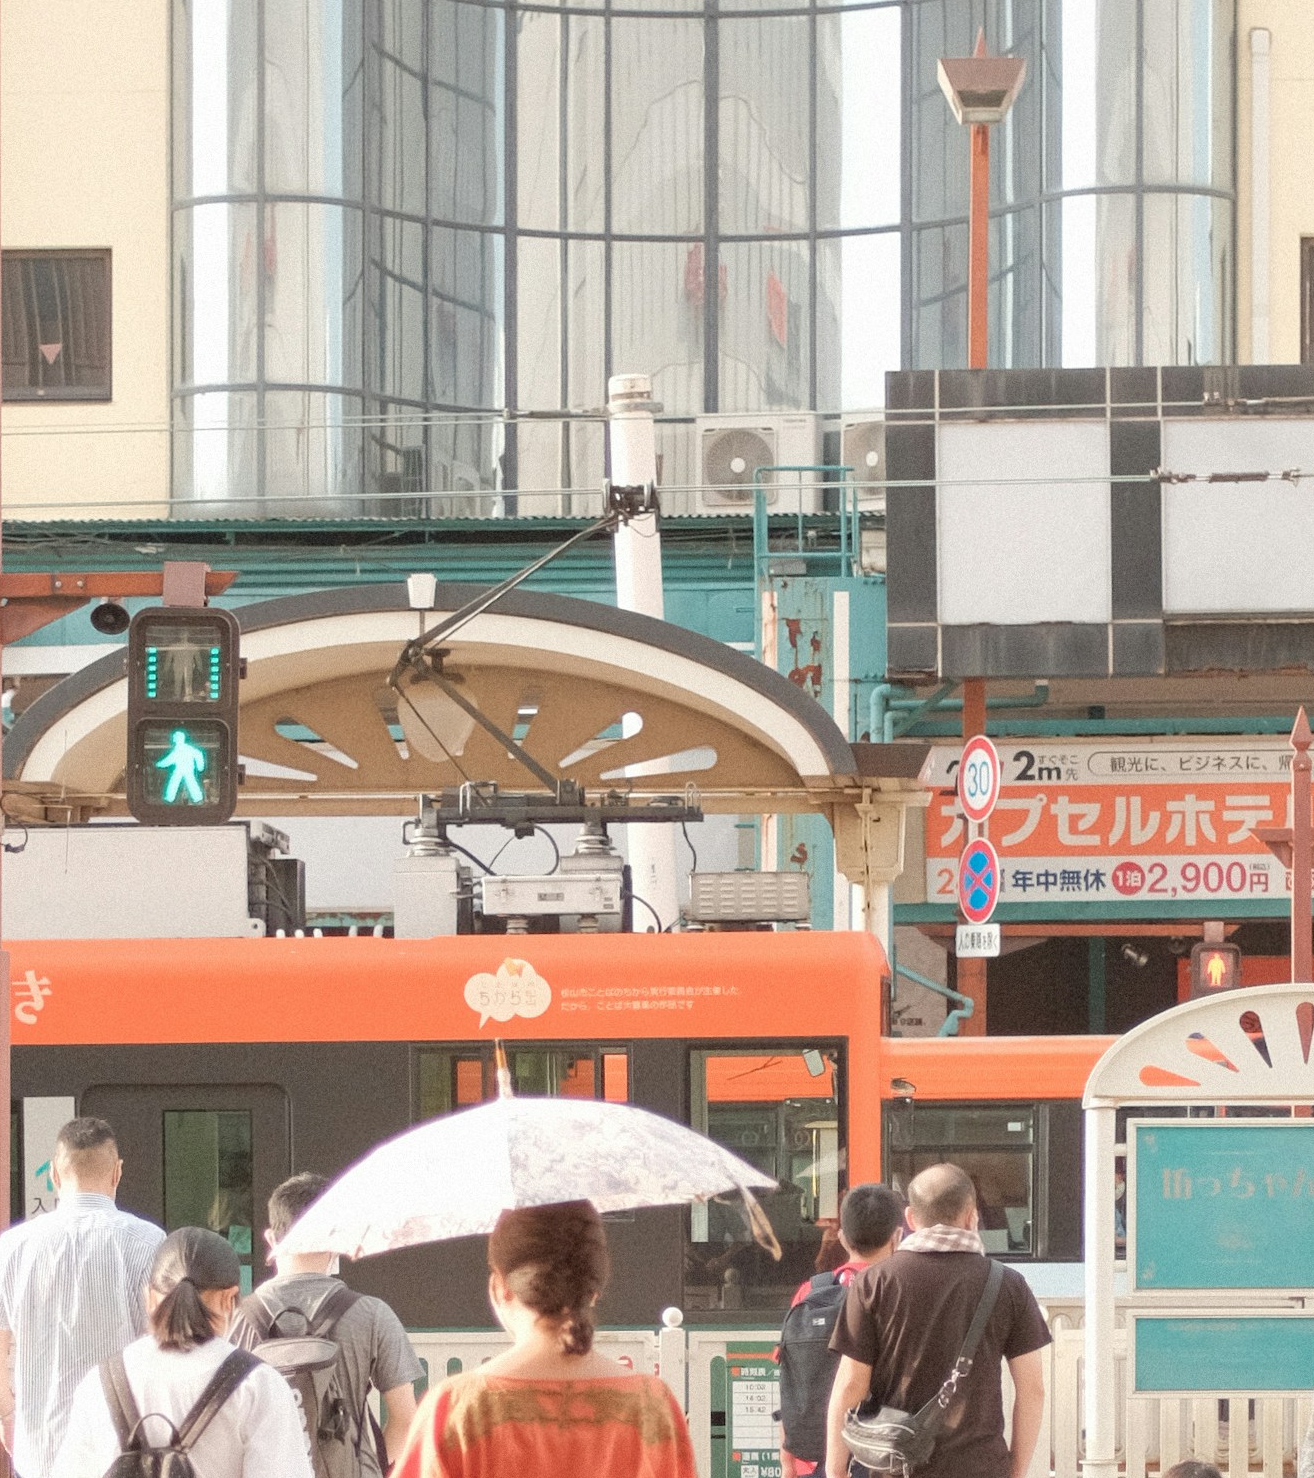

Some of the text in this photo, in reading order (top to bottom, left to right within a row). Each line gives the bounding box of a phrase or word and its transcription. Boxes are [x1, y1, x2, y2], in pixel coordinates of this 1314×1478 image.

[967, 761, 990, 798] 30
[1012, 869, 1107, 893] 年中無休
